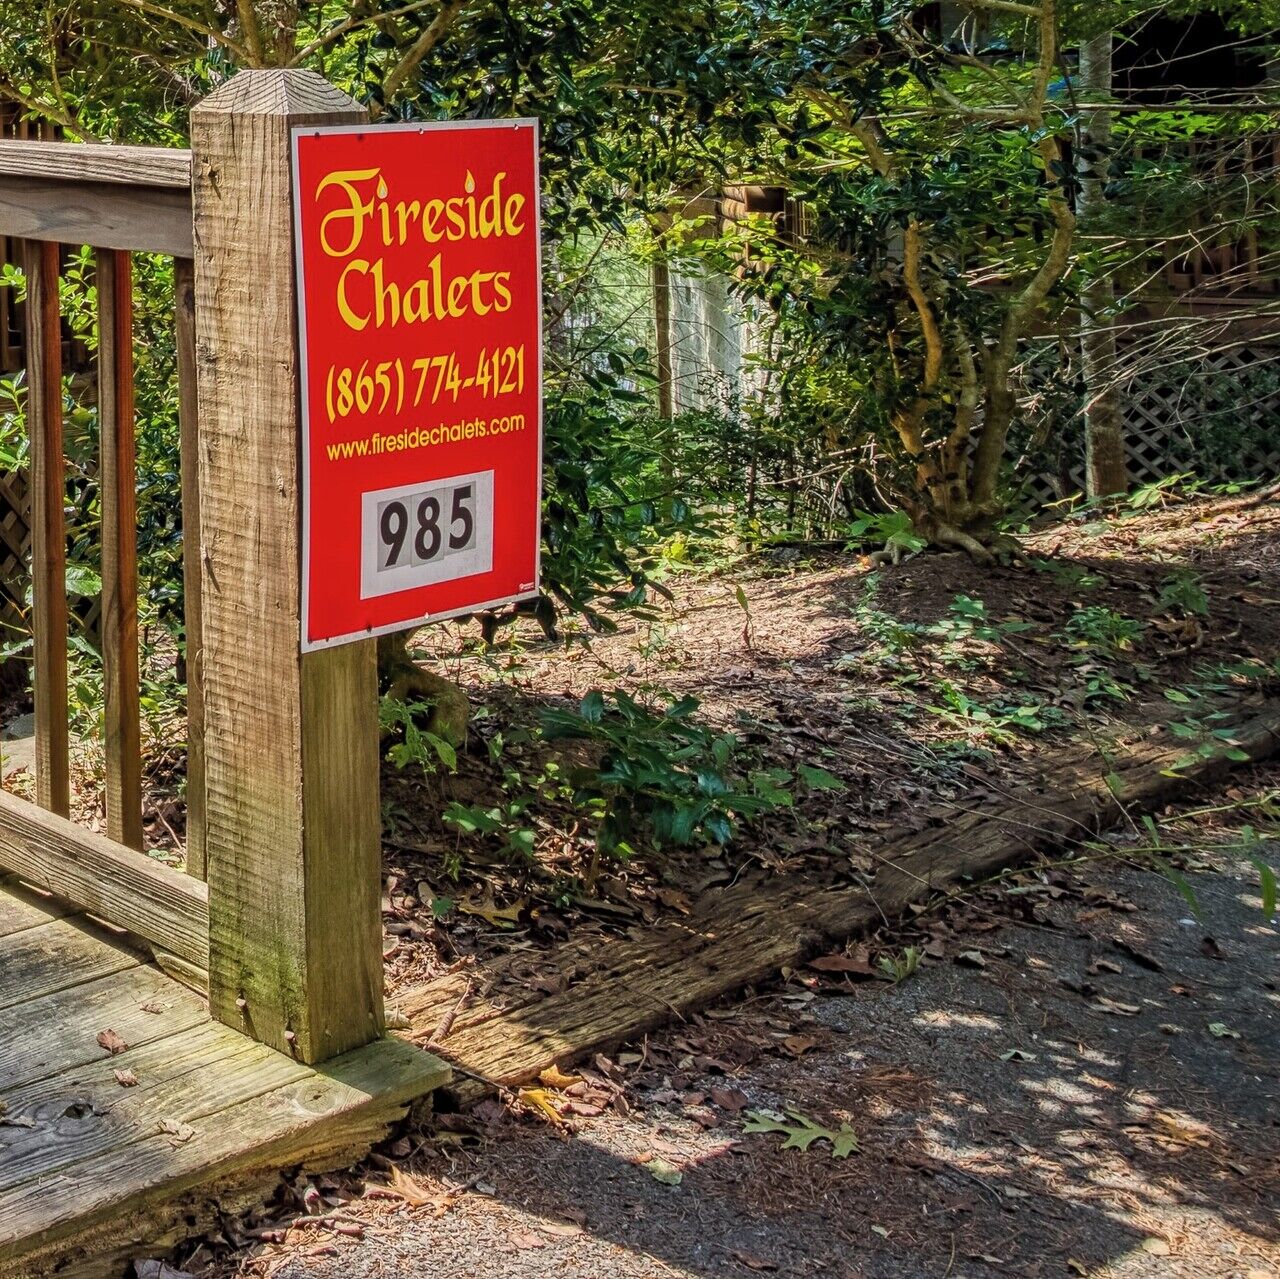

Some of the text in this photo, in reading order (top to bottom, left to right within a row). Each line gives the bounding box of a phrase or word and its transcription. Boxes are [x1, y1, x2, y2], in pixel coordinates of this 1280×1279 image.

[315, 167, 526, 258] Fireside
[336, 252, 512, 331] Chalets
[326, 343, 525, 425] (865) 774-4121
[326, 414, 525, 462] www.firesidechalets.com
[379, 484, 474, 568] 985
